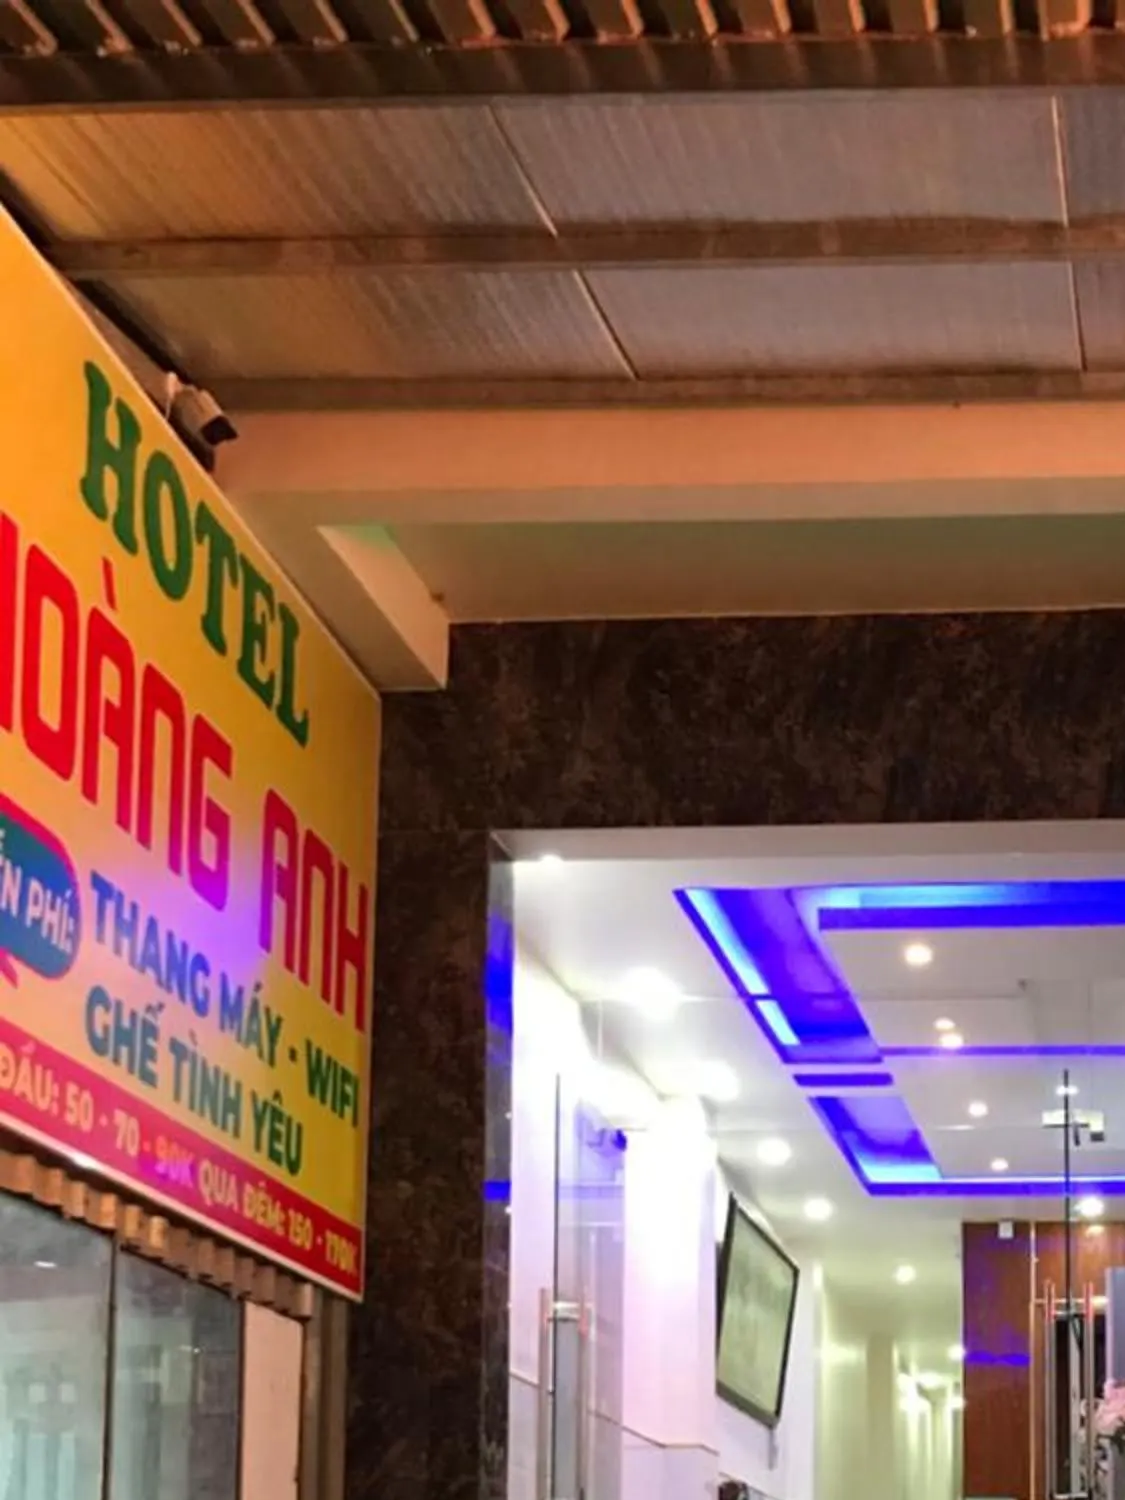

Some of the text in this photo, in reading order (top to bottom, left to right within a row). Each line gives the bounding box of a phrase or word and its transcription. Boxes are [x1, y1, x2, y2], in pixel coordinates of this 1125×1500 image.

[80, 361, 309, 748] HOTEL
[90, 869, 210, 1018] THANG
[219, 971, 283, 1068] MÁY
[306, 1038, 360, 1128] WIFI
[260, 788, 368, 1034] ANH
[64, 1080, 94, 1133] 50
[113, 1107, 140, 1158] 70
[200, 1158, 239, 1214] QUA
[85, 985, 303, 1177] GHẾ TÌNH YÊU
